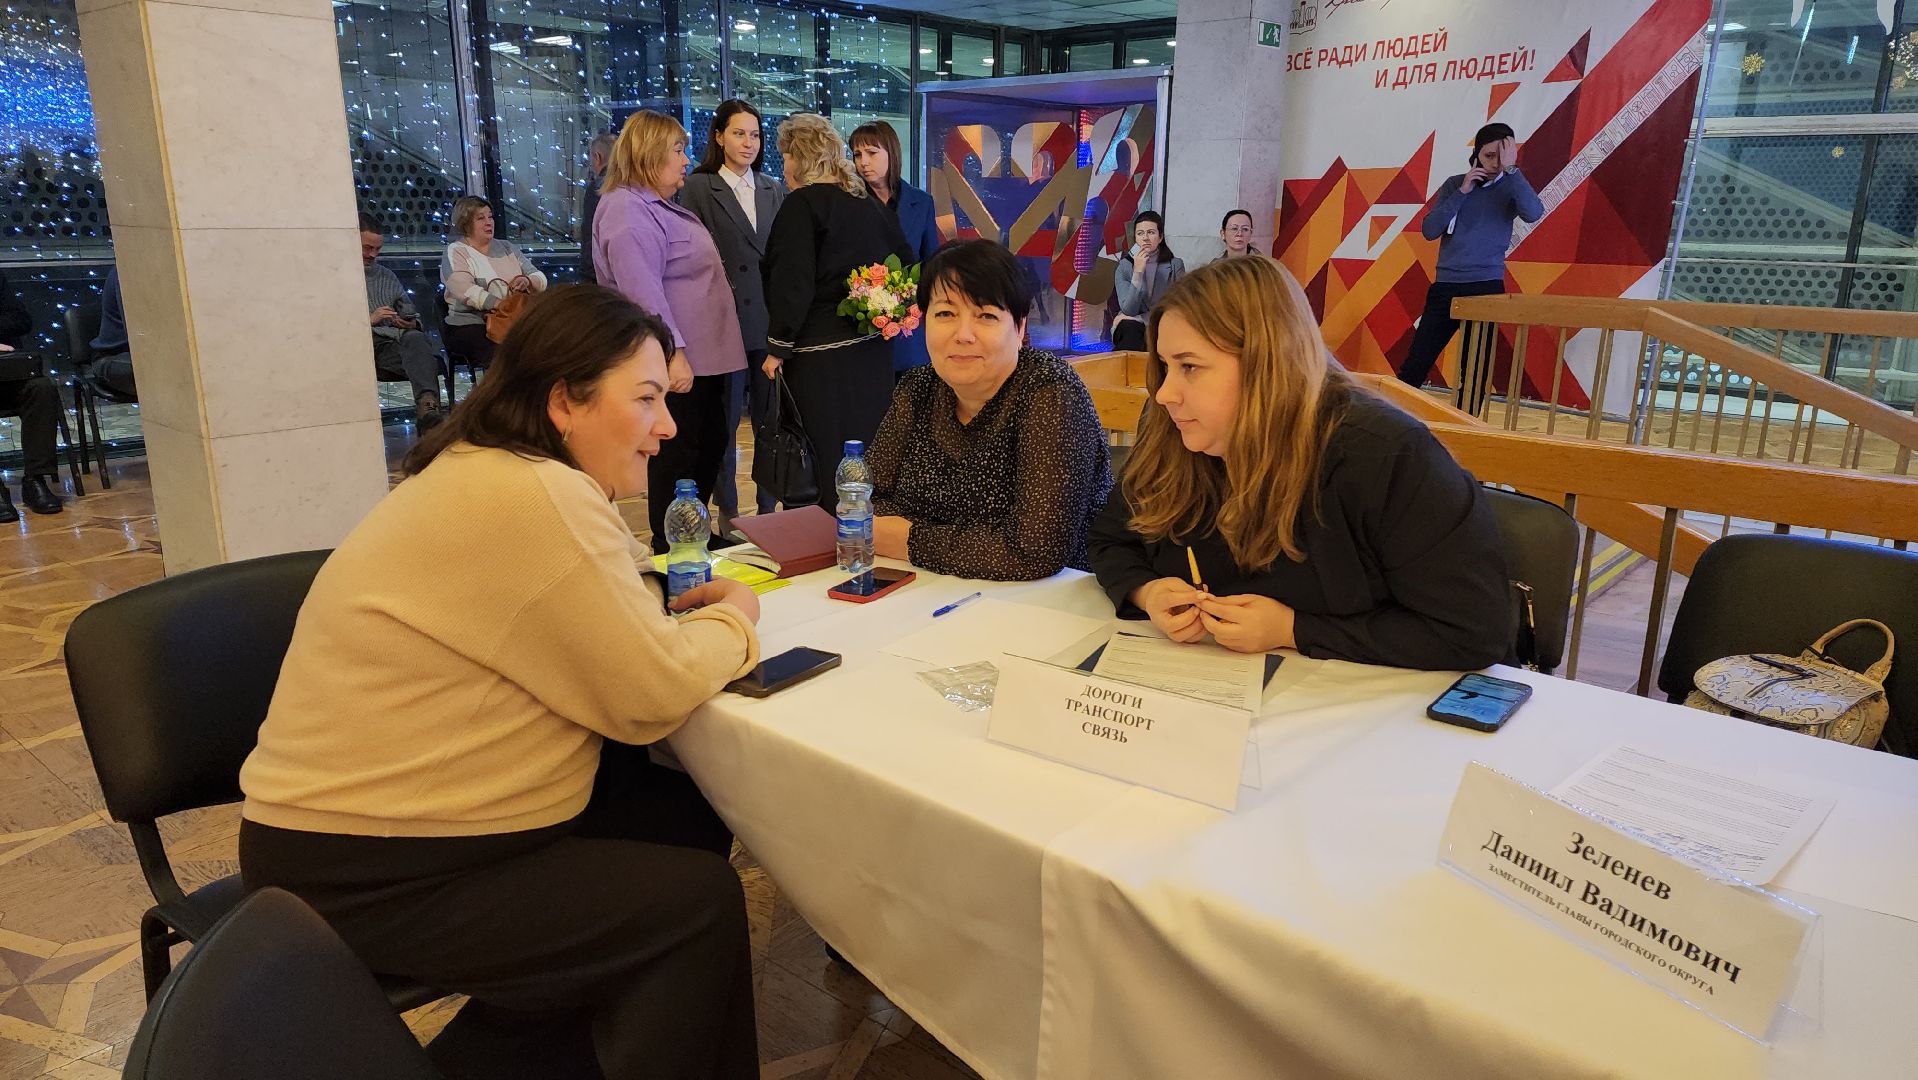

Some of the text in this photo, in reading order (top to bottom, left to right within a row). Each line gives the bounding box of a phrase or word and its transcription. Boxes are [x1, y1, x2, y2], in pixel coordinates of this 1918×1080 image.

[1318, 43, 1367, 68] РАДИ
[1372, 27, 1448, 60] ЛЮДЕЙ
[1375, 46, 1536, 90] И ДЛЯ ЛЮДЕЙ!
[1065, 698, 1155, 731] ТРАНСПОРТ
[1080, 684, 1143, 709] ДОРОГИ
[1082, 721, 1128, 743] СВЯЗЬ
[1565, 831, 1672, 900] Зеленев
[1481, 830, 1742, 984] Даниил Вадимович
[1488, 863, 1714, 996] ЗАМЕСТИТЕЛЬ ГЛАВЫ ГОРОДСКОГО ОКРУГА
